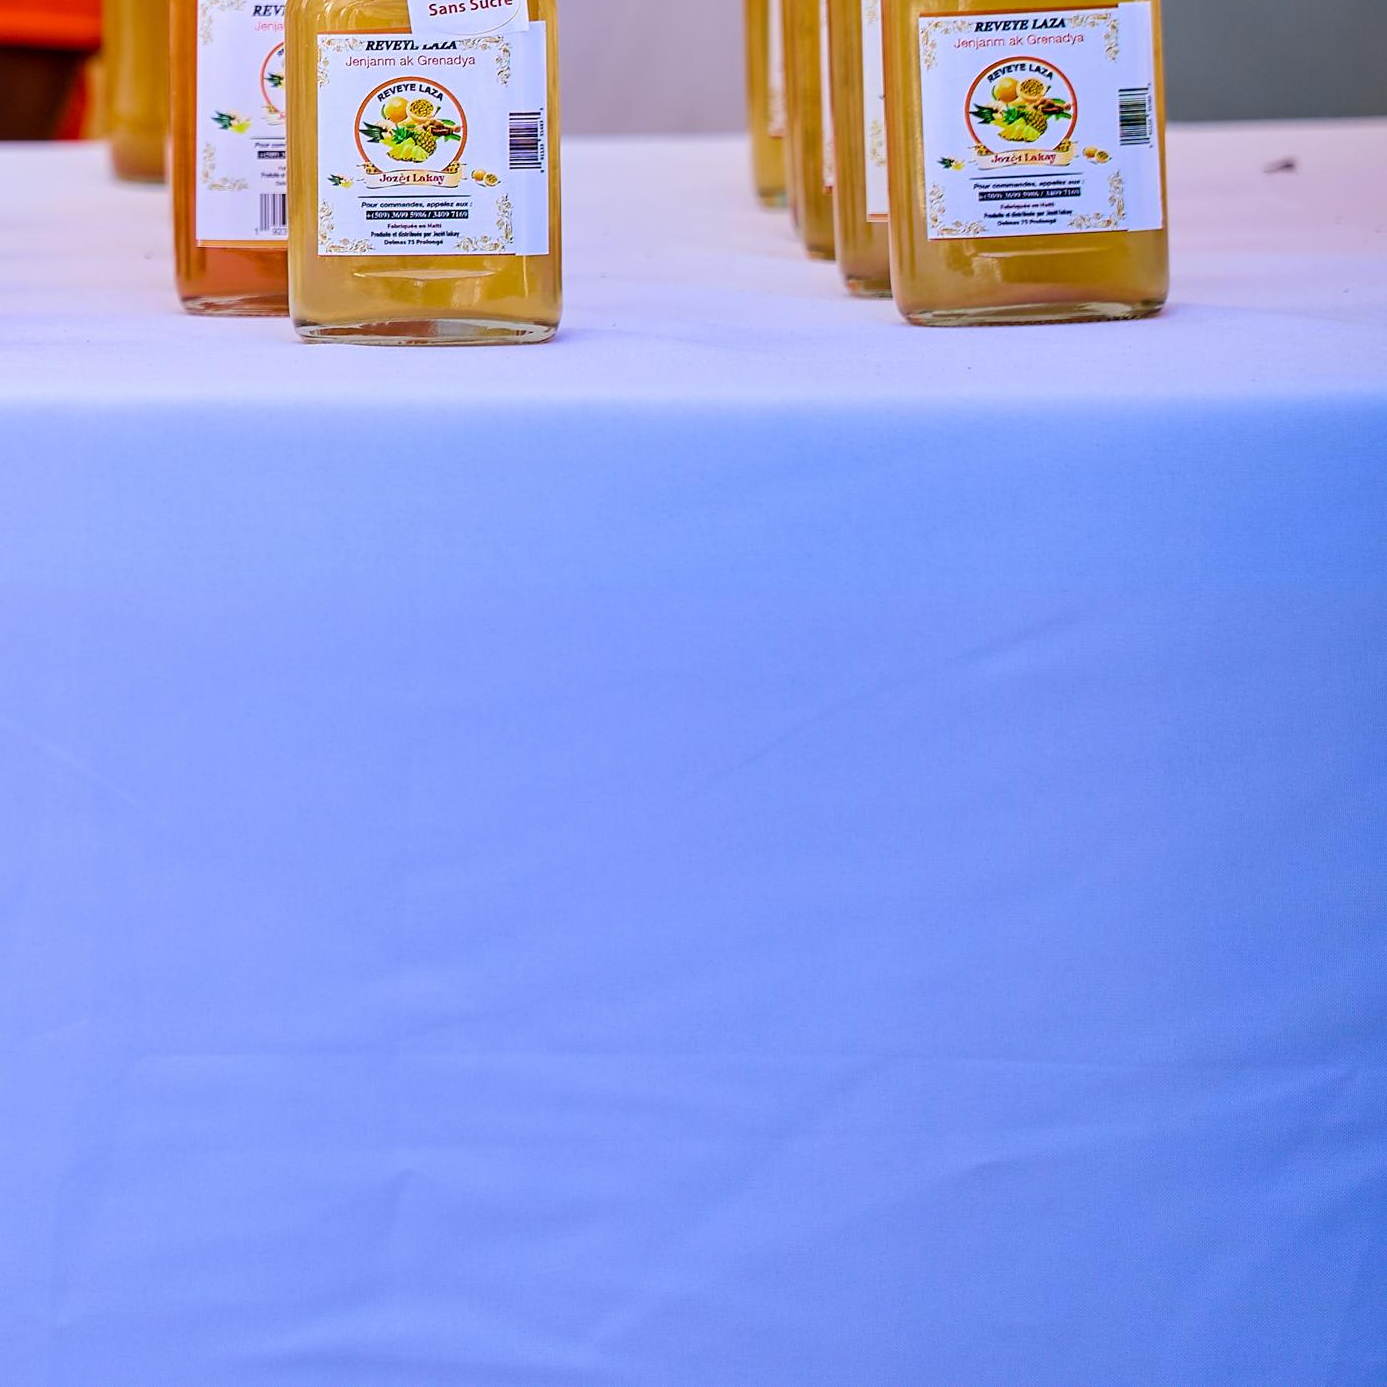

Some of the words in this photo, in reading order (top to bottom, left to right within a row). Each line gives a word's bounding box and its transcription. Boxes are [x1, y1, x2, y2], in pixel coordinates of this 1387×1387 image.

[251, 5, 285, 17] REV
[428, 2, 466, 16] Sans
[254, 22, 283, 32] Jenja
[975, 20, 1029, 32] REVEYE
[1031, 18, 1066, 29] LAZA
[954, 38, 1004, 49] Jenjanm
[1009, 36, 1023, 46] ak
[1027, 33, 1084, 45] Grenadya
[346, 56, 396, 68] Jenjanm
[399, 56, 414, 66] ak
[417, 55, 475, 67] Grenadya
[987, 63, 1026, 83] REVEYE
[1029, 64, 1053, 80] LAZA
[377, 83, 416, 102] REVEYE
[418, 84, 444, 101] LAZA
[413, 174, 445, 184] Lakay
